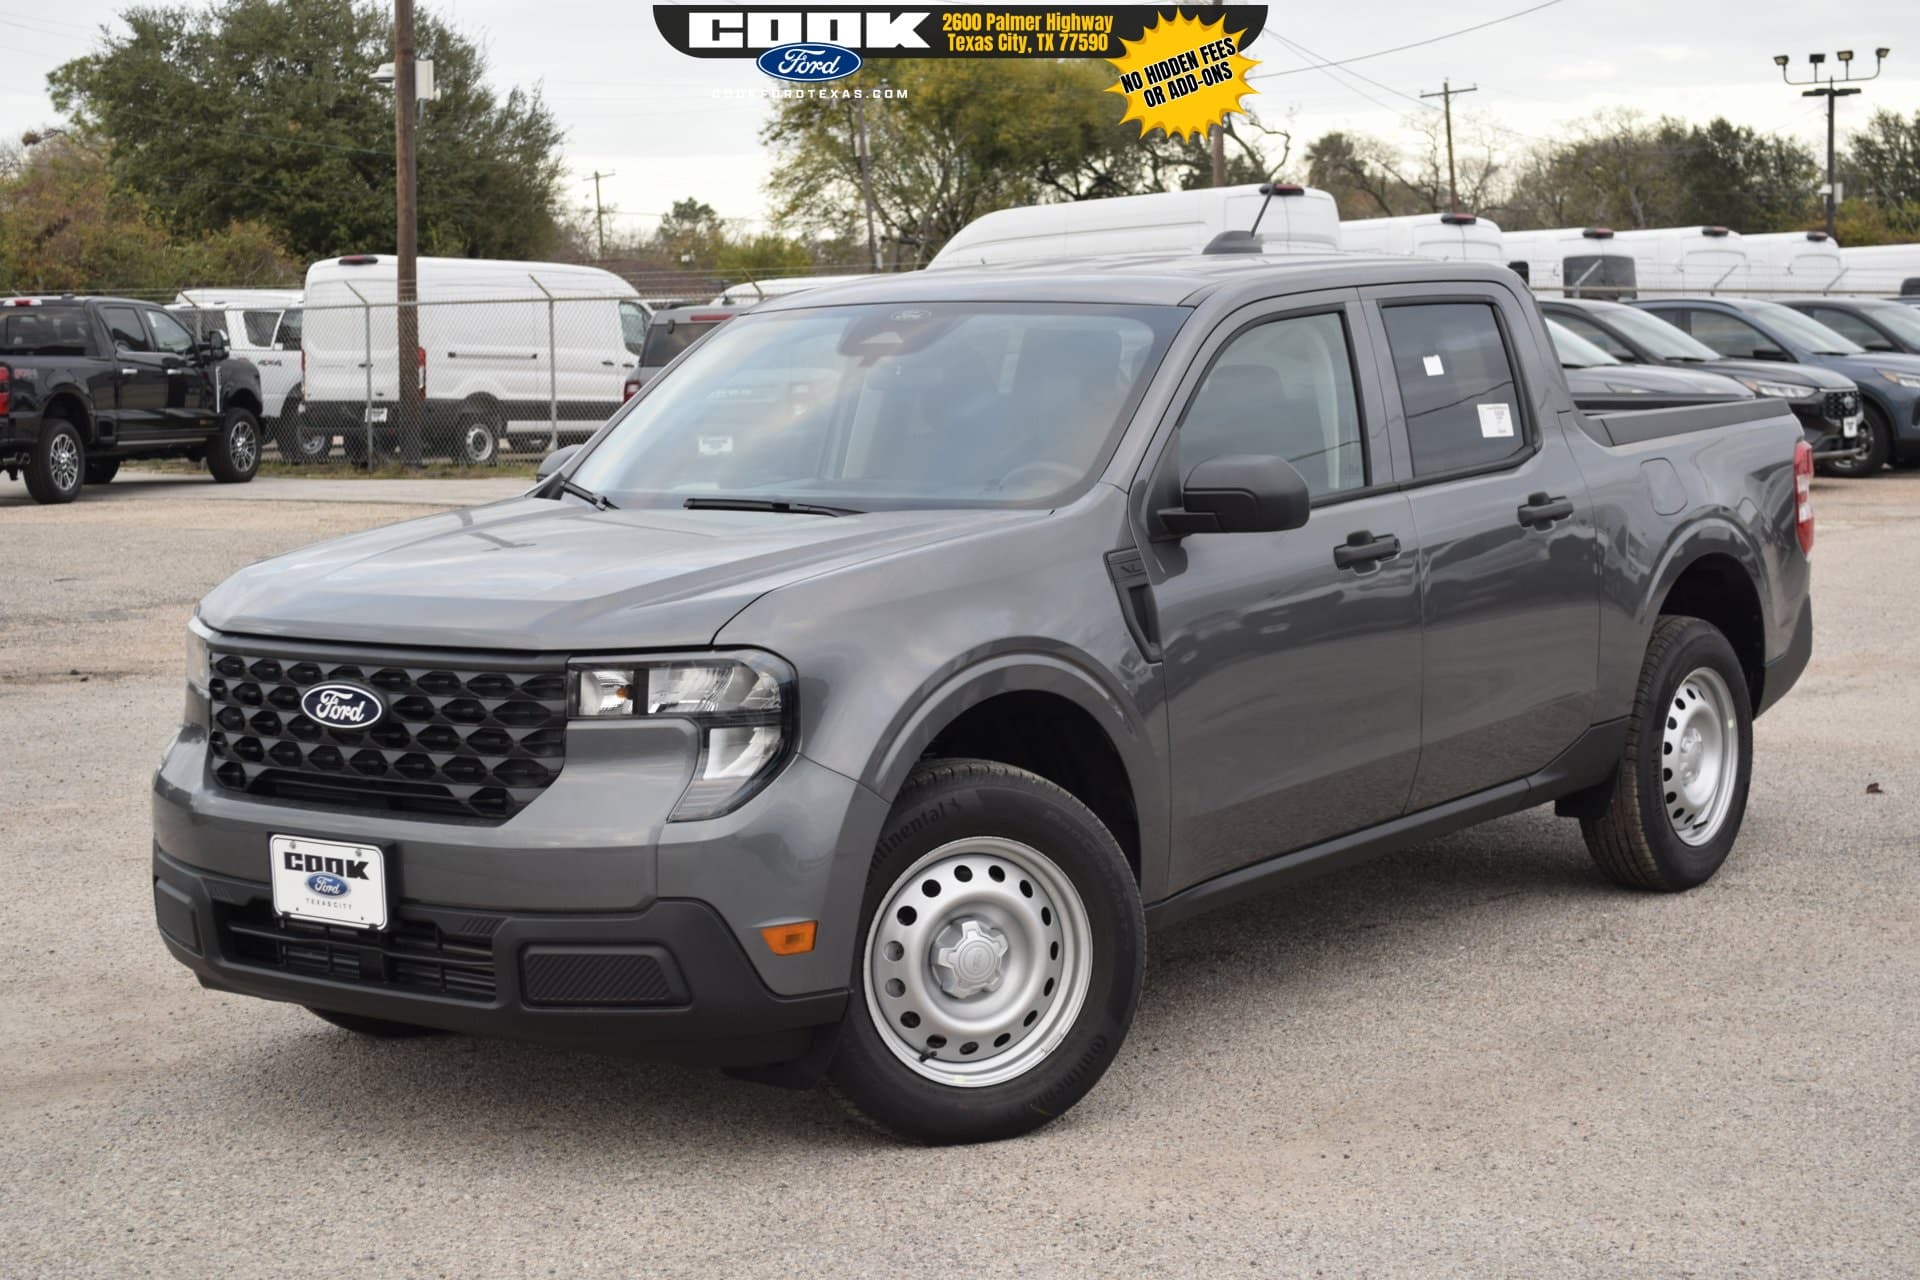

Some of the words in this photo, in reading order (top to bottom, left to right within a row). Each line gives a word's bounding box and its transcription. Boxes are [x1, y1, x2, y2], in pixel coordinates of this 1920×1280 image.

[316, 690, 366, 722] Ford
[284, 851, 370, 881] COOK
[314, 876, 341, 895] Ford
